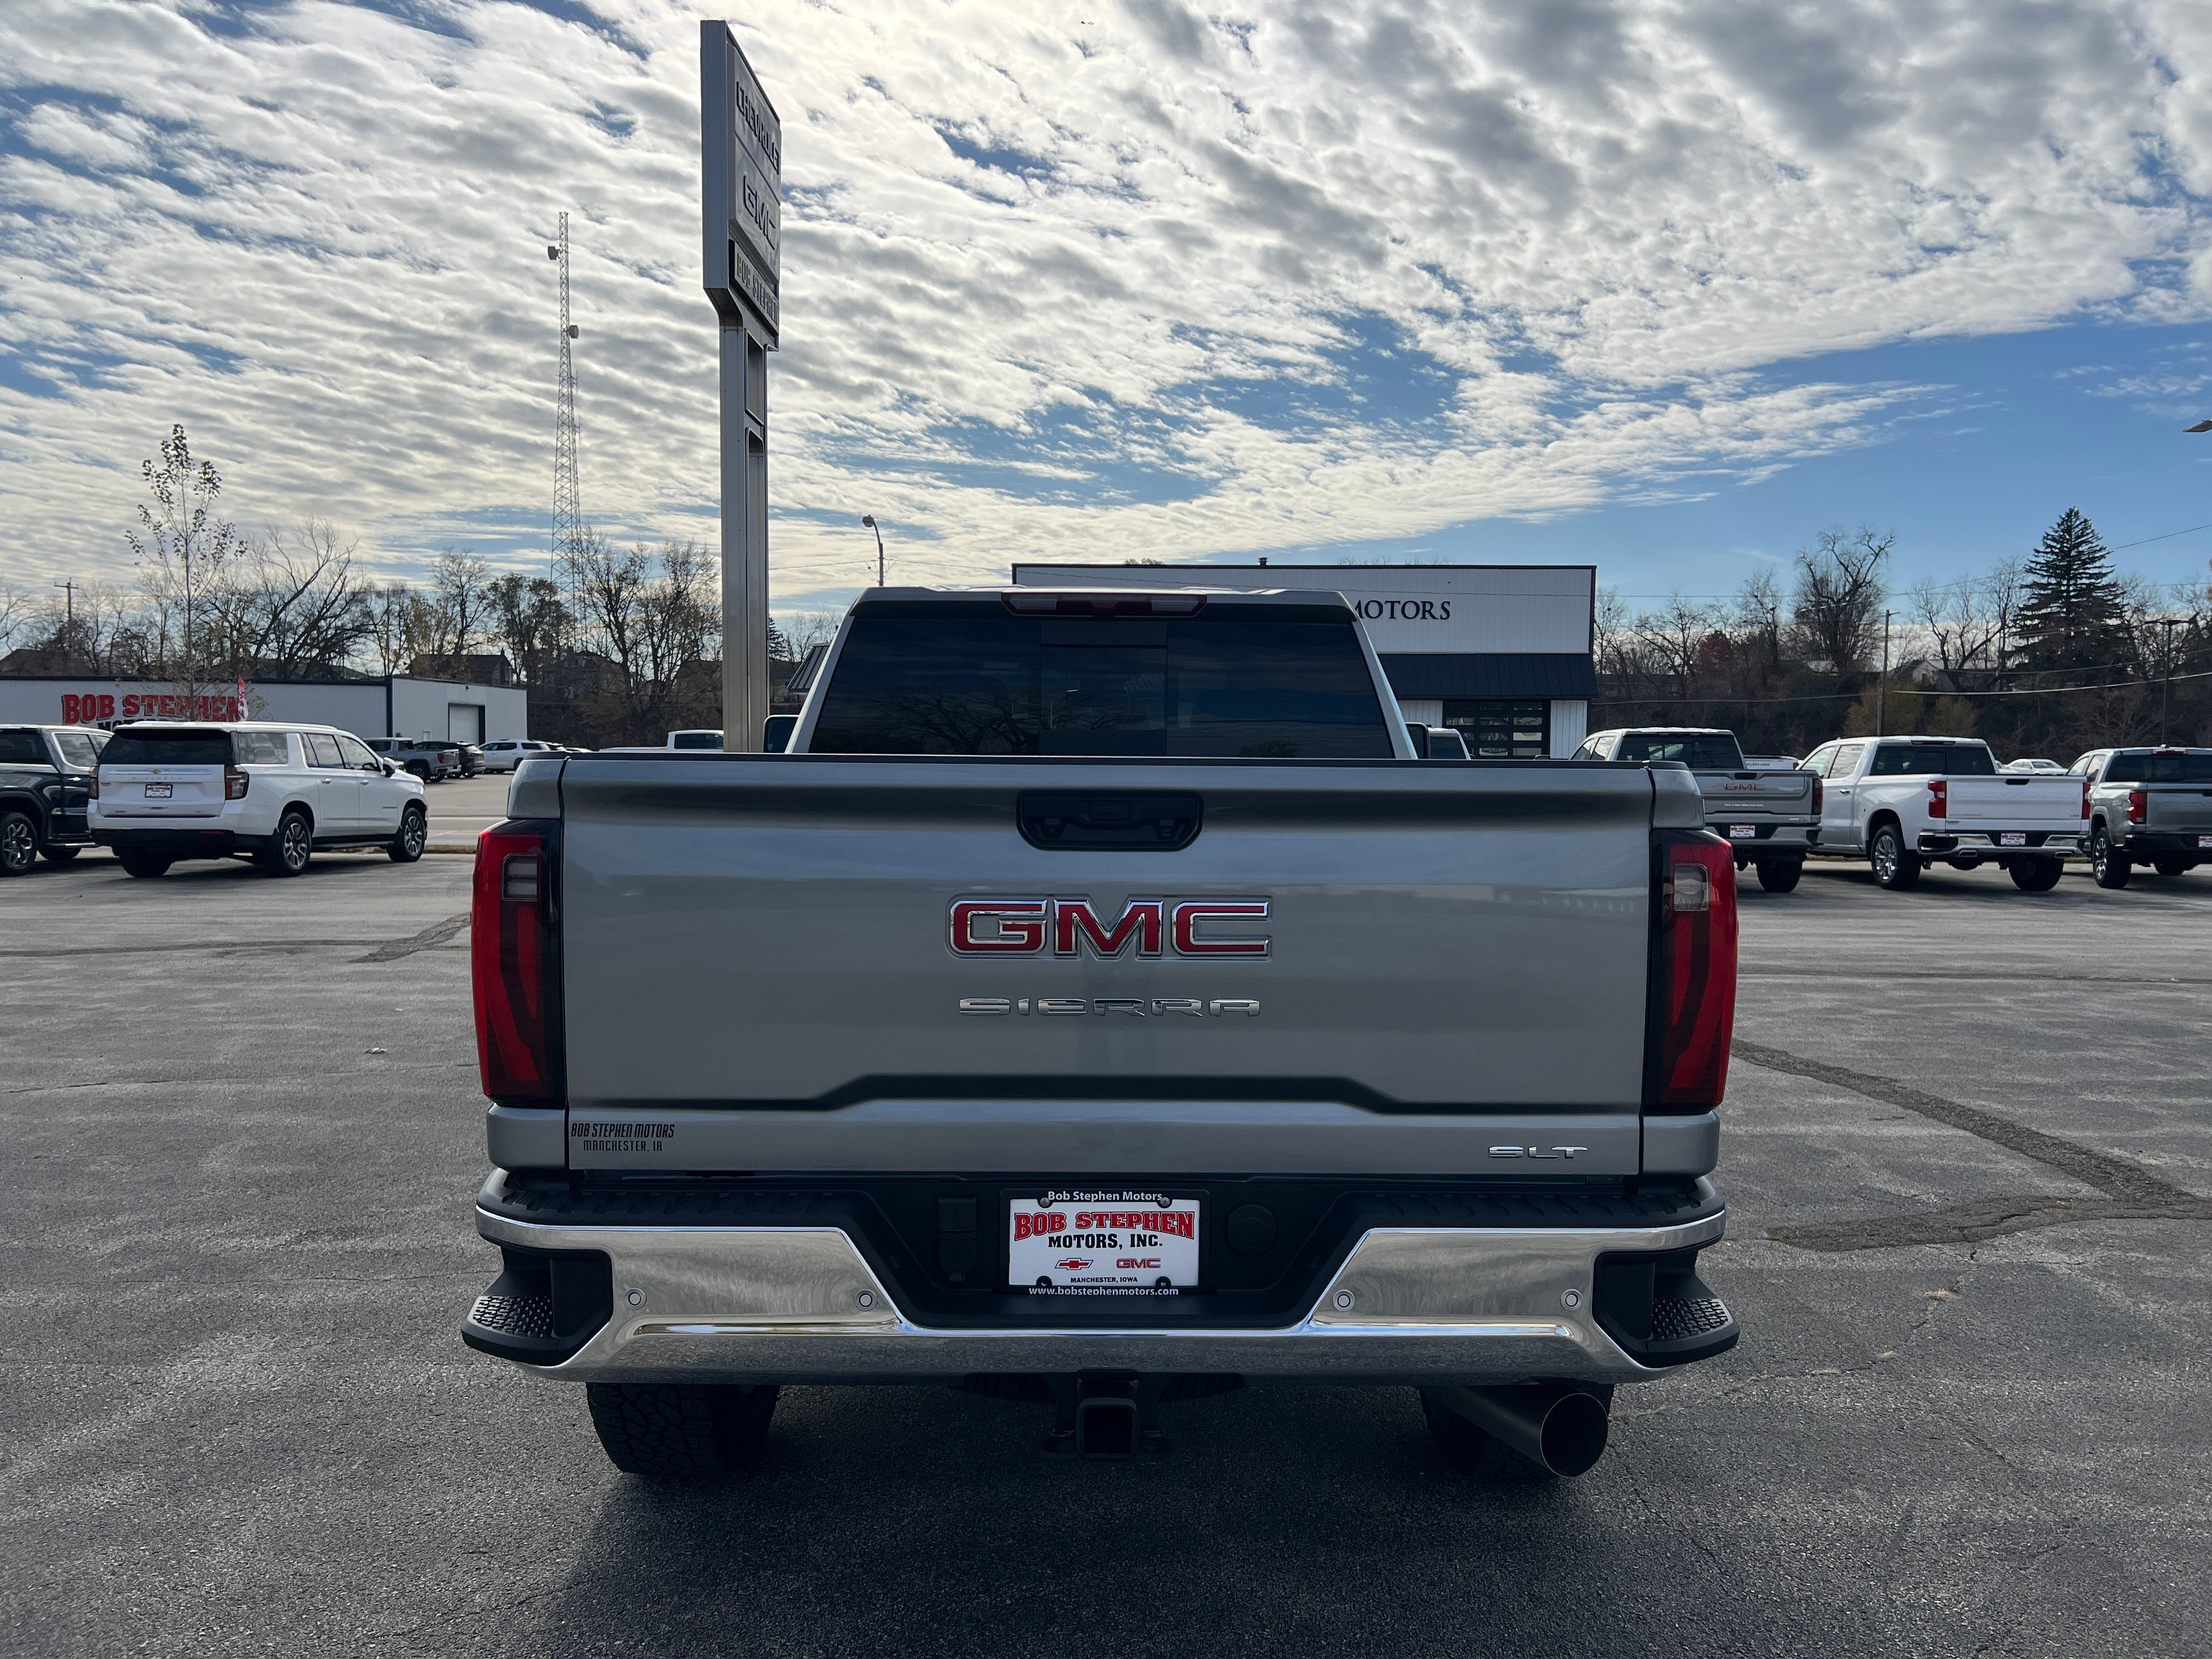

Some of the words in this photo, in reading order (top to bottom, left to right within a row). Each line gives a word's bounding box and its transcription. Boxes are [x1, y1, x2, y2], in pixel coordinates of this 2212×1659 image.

[736, 81, 780, 175] CHEVROLET
[743, 175, 776, 250] GMC
[737, 252, 751, 289] BOB
[752, 270, 778, 325] STEPHEN
[61, 694, 115, 725] BOB
[122, 695, 239, 721] STEPHEN
[950, 899, 1269, 956] GMC
[959, 998, 1261, 1017] SIERRA
[571, 1123, 590, 1137] BOB
[591, 1123, 631, 1137] STEPHEN
[634, 1124, 675, 1138] MOTORS
[653, 1141, 662, 1152] IA
[1488, 1146, 1588, 1159] SLT
[1048, 1191, 1070, 1200] Bob
[1073, 1191, 1120, 1202] Stephen
[1122, 1192, 1163, 1201] Motors
[1014, 1212, 1067, 1242] BOB
[1075, 1211, 1195, 1239] STEPHEN
[1048, 1234, 1123, 1250] MOTORS,
[1130, 1234, 1163, 1248] INC.
[1116, 1258, 1161, 1269] GMC
[1029, 1286, 1179, 1296] www.bobstephenmotors.com
